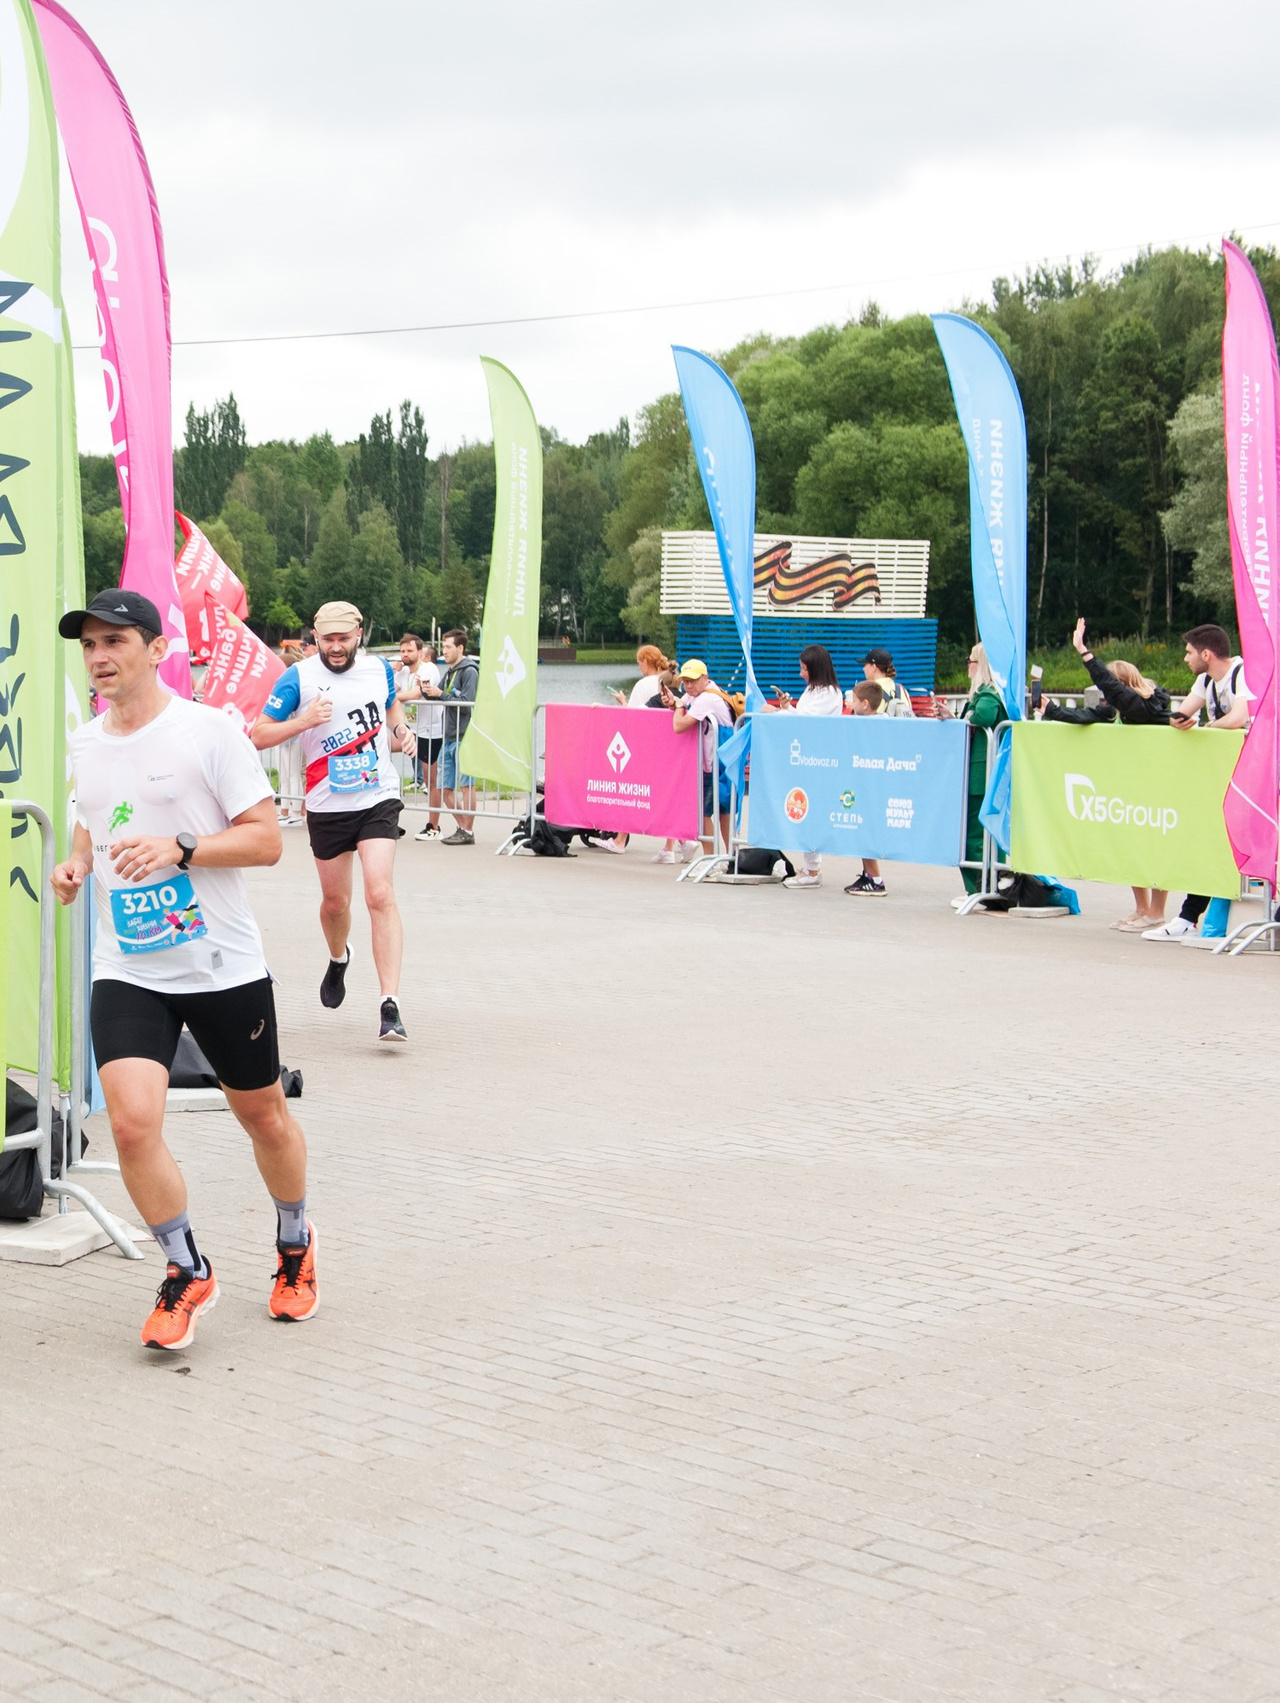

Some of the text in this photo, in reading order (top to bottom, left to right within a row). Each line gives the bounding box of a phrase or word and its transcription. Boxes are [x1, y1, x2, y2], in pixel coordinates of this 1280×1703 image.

[347, 700, 383, 737] ЗА
[321, 727, 355, 753] 2022
[334, 755, 370, 772] 3338
[852, 755, 917, 772] Белая Дача
[586, 779, 651, 797] ЛИНИЯ ЖИЗНИ
[637, 801, 651, 811] фонд
[887, 798, 913, 809] СОЮЗ
[829, 812, 863, 824] СТЕПЬ
[885, 808, 914, 819] МУЛЬТ
[887, 818, 911, 829] ПАРК
[120, 885, 178, 915] 3210
